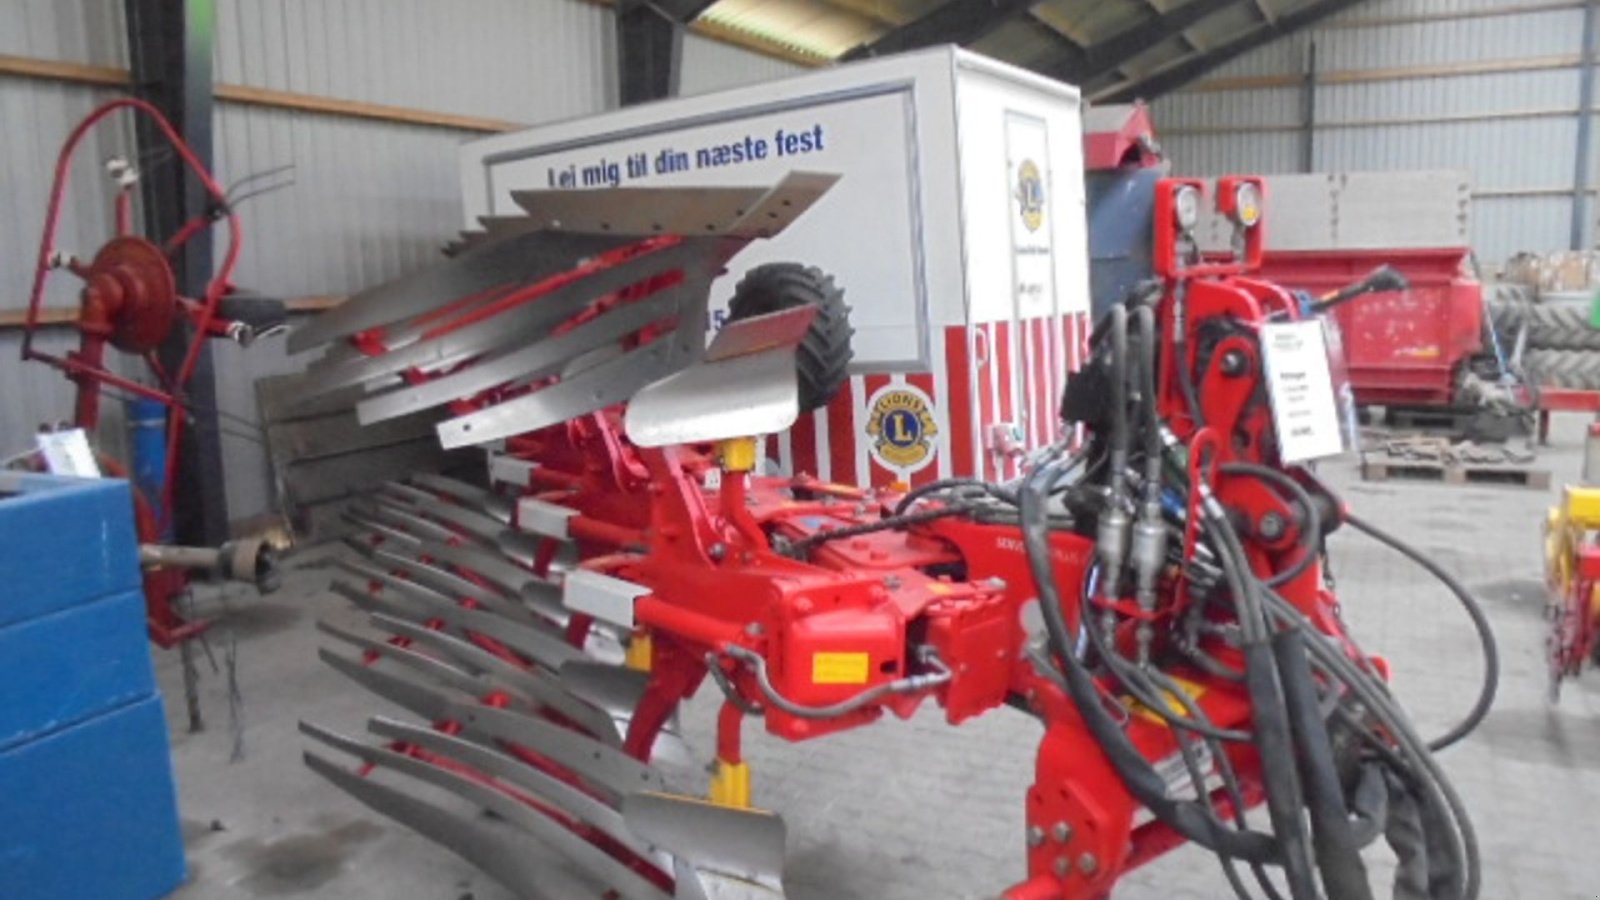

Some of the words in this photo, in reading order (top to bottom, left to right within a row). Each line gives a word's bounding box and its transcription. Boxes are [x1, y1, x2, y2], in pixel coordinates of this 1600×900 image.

[582, 157, 620, 187] mig
[627, 152, 647, 178] til
[655, 148, 688, 174] din
[696, 136, 767, 168] næste
[775, 123, 823, 156] fest
[880, 394, 921, 409] LIONS
[892, 414, 913, 441] L
